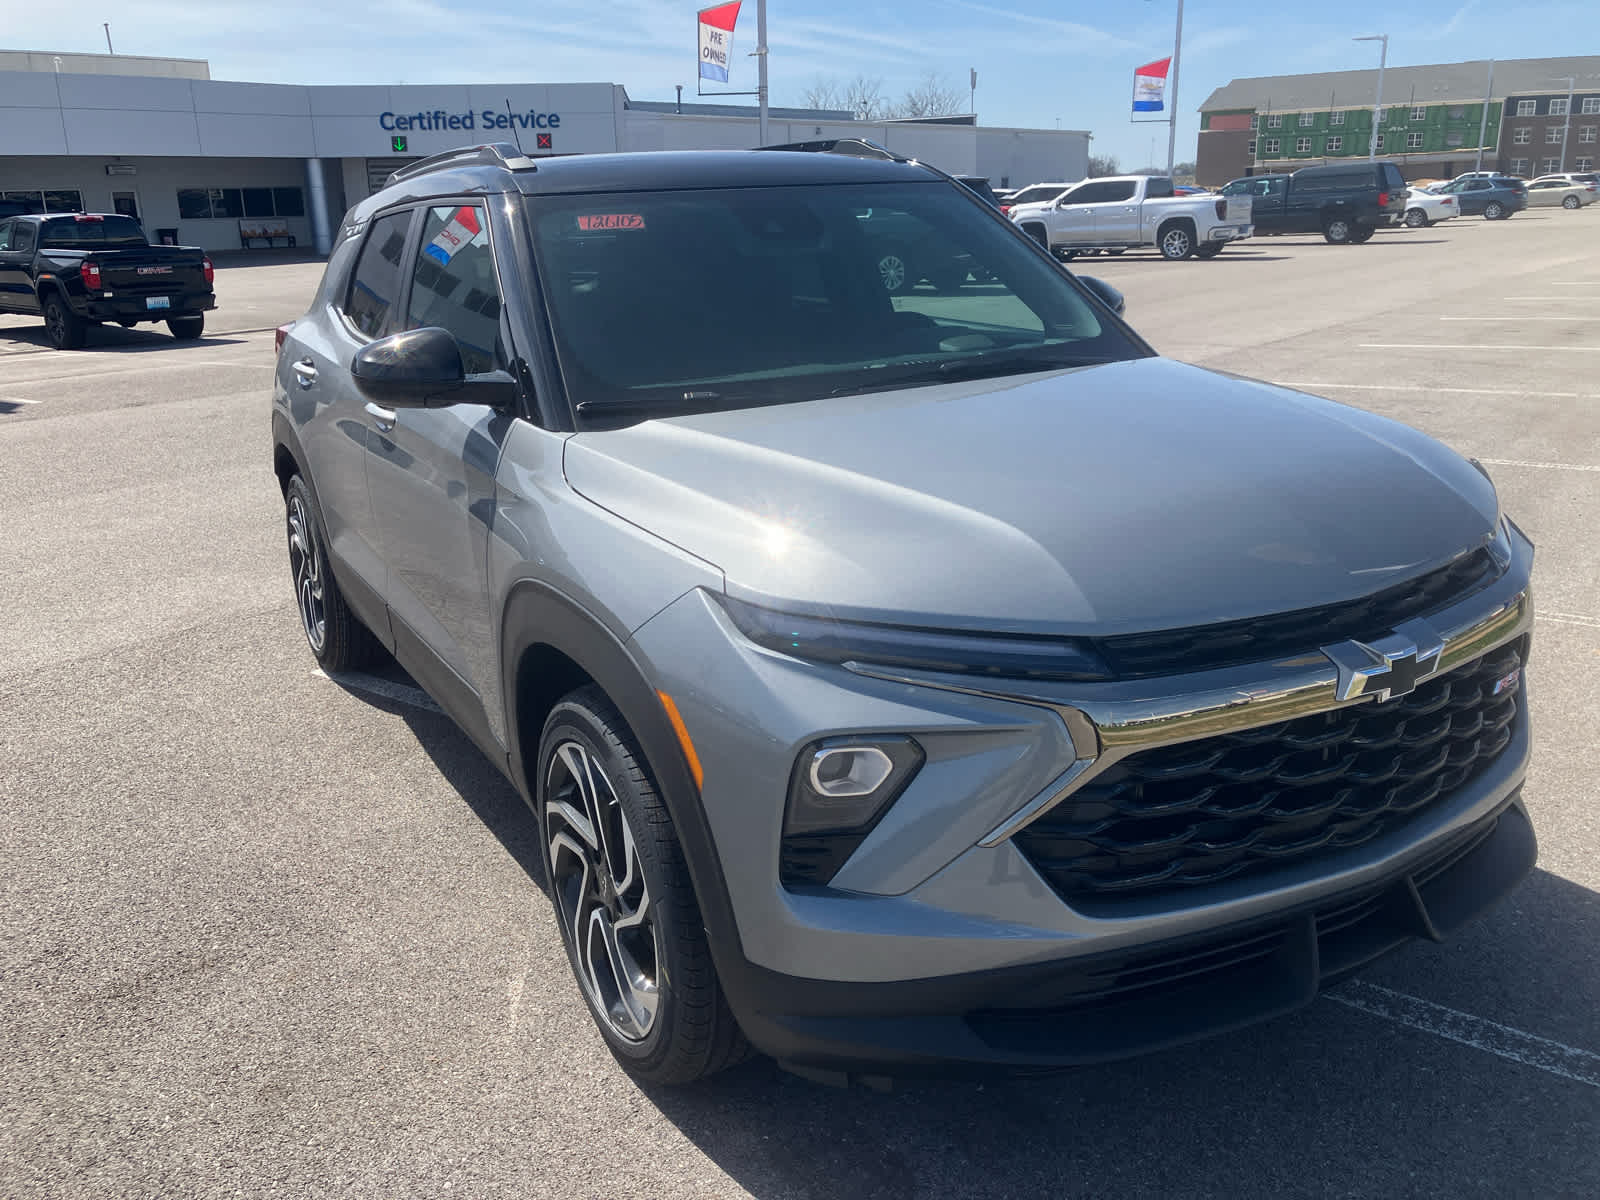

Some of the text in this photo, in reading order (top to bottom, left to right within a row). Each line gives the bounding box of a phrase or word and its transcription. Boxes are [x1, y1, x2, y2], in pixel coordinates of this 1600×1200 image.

[710, 31, 722, 45] PRE
[703, 47, 726, 64] OWNED
[380, 109, 560, 131] Certified Service
